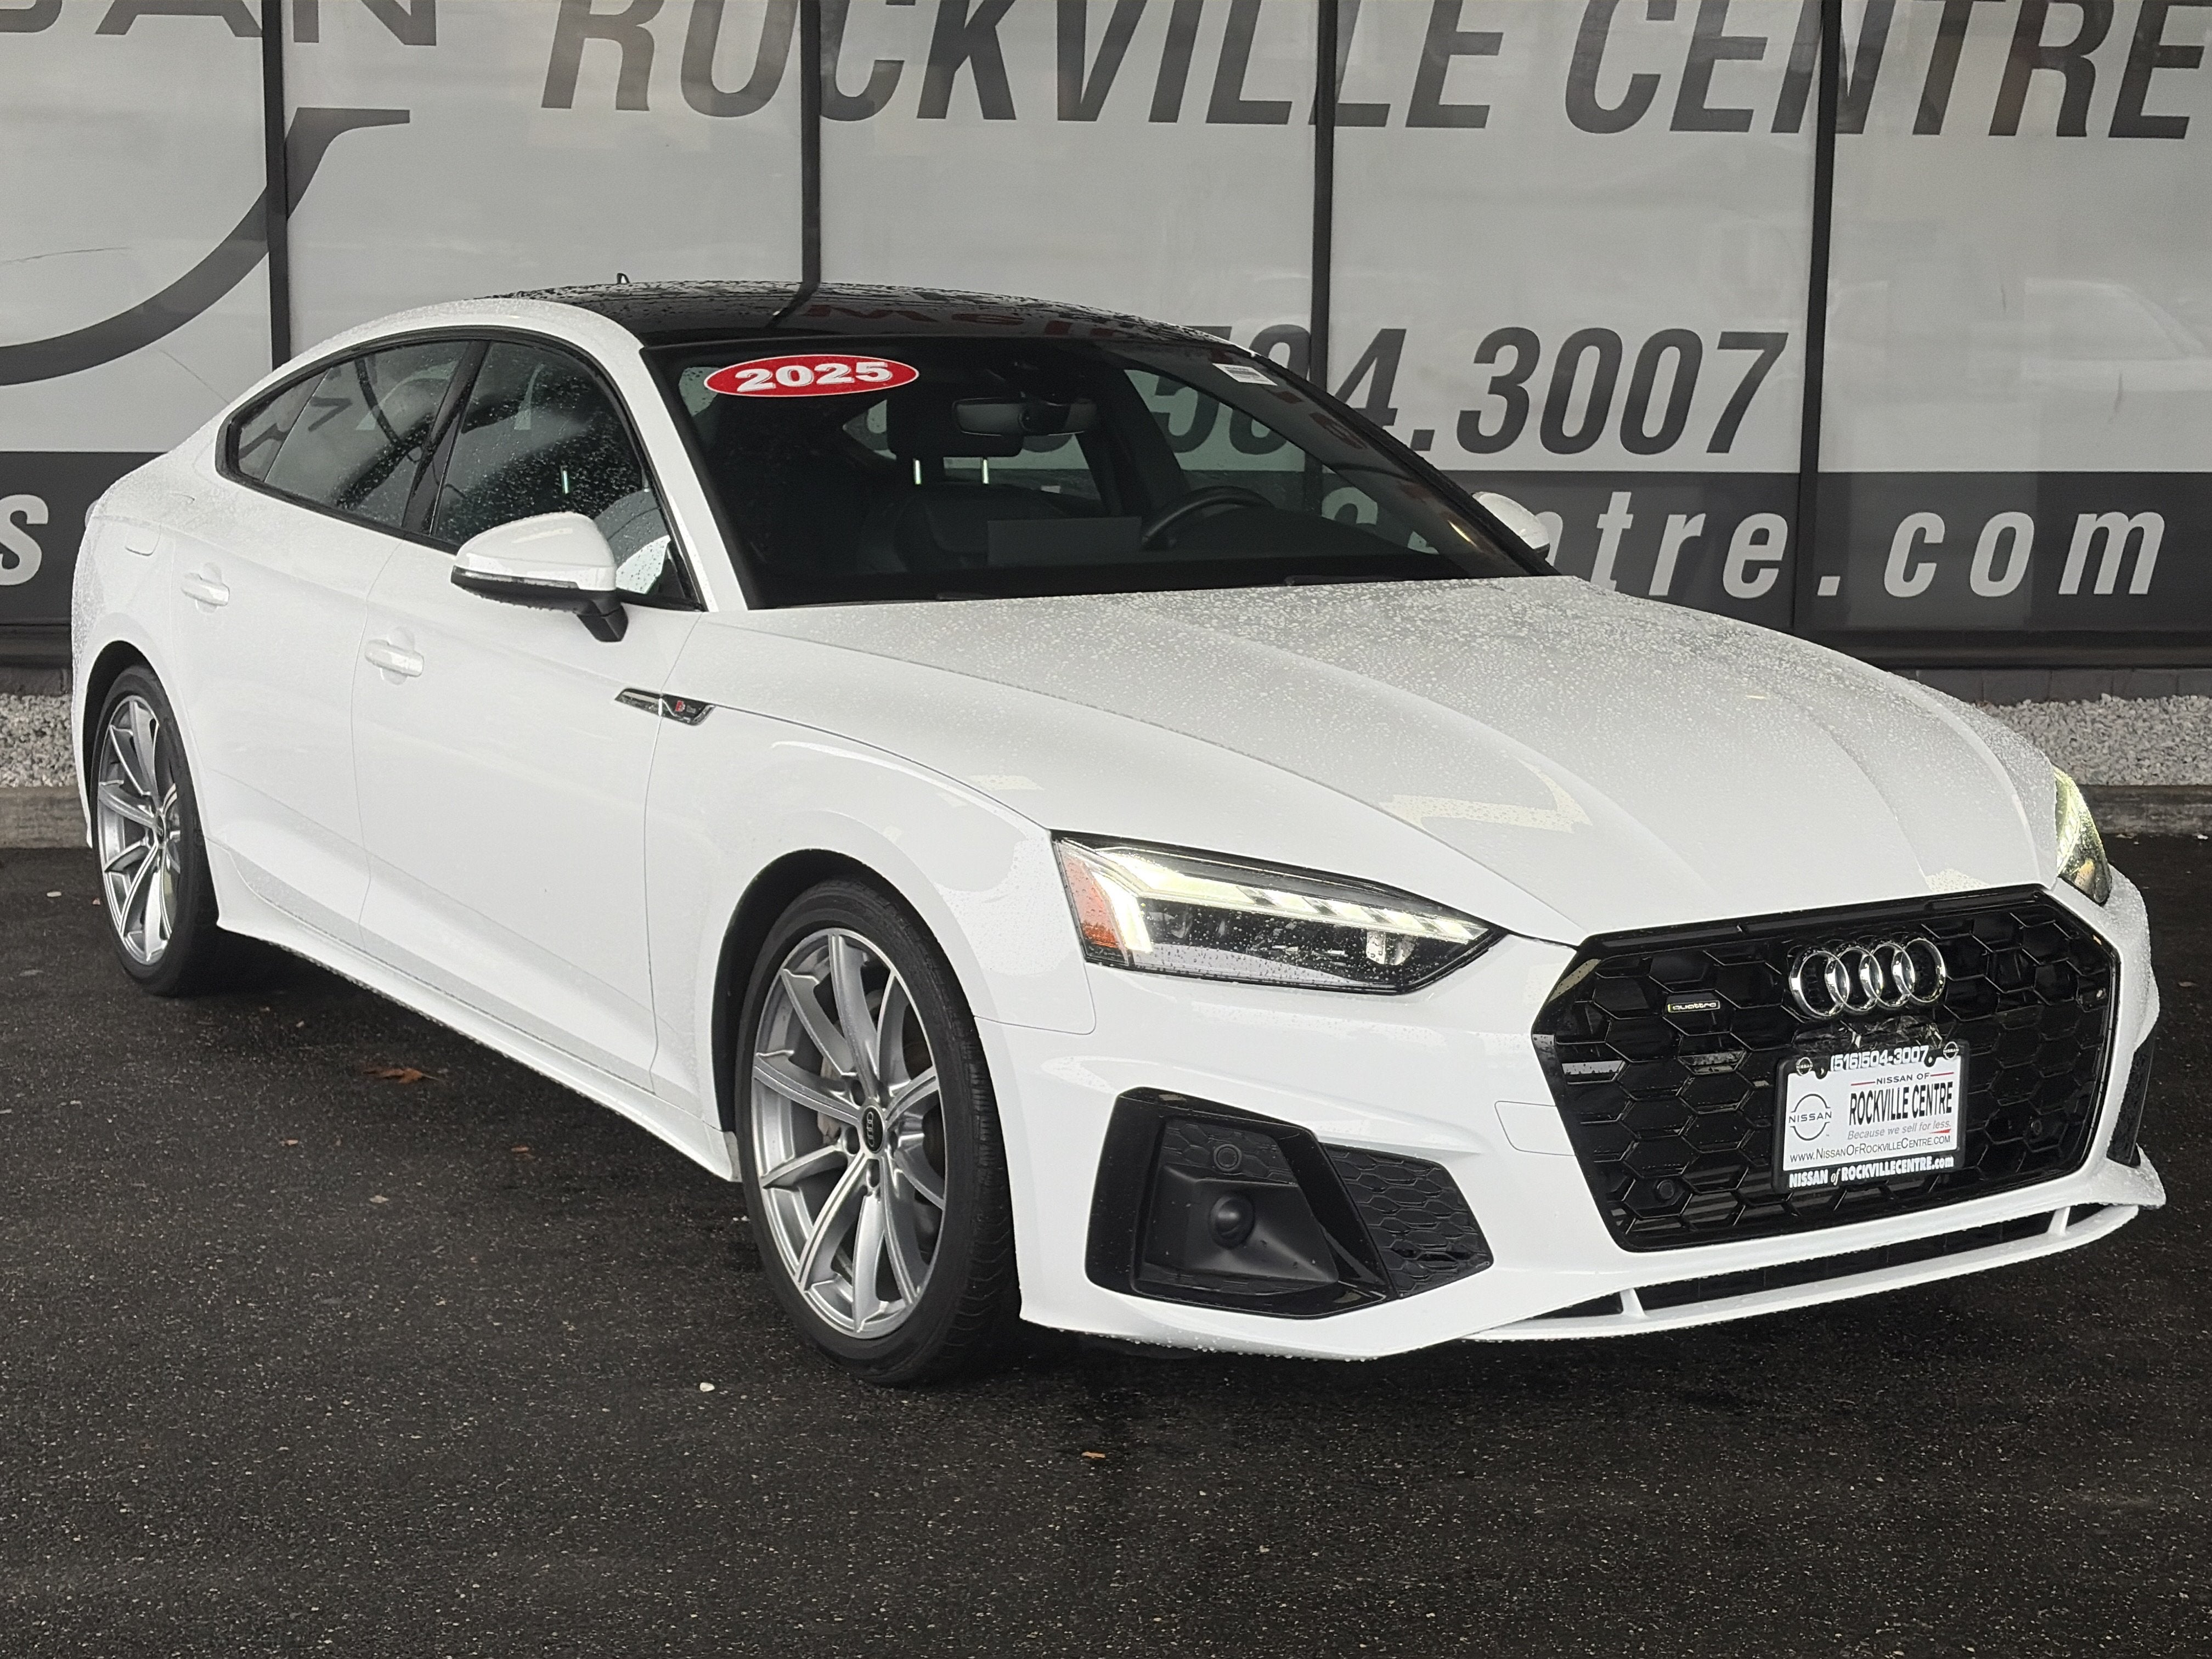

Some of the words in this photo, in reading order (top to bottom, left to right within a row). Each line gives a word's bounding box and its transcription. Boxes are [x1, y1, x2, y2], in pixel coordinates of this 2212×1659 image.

[541, 0, 1502, 128] ROCKVILLE
[1565, 0, 2211, 140] CENTRE
[736, 362, 894, 392] 2025
[1672, 1002, 1717, 1011] quattro
[1830, 1045, 1929, 1071] (516)504-3007
[1876, 1074, 1913, 1085] NISSAN
[1916, 1072, 1930, 1080] OF
[1849, 1087, 1909, 1125] ROCKVILLE
[1912, 1081, 1953, 1119] CENTRE
[1788, 1111, 1832, 1124] NISSAN
[1848, 1128, 1885, 1140] Because
[1888, 1126, 1900, 1135] we
[1902, 1122, 1917, 1133] sell
[1919, 1122, 1931, 1131] for
[1933, 1120, 1951, 1129] less.
[1789, 1169, 1829, 1188] NISSAN
[1830, 1168, 1841, 1186] of
[1841, 1155, 1954, 1182] ROCKVILLECENTRE.com
